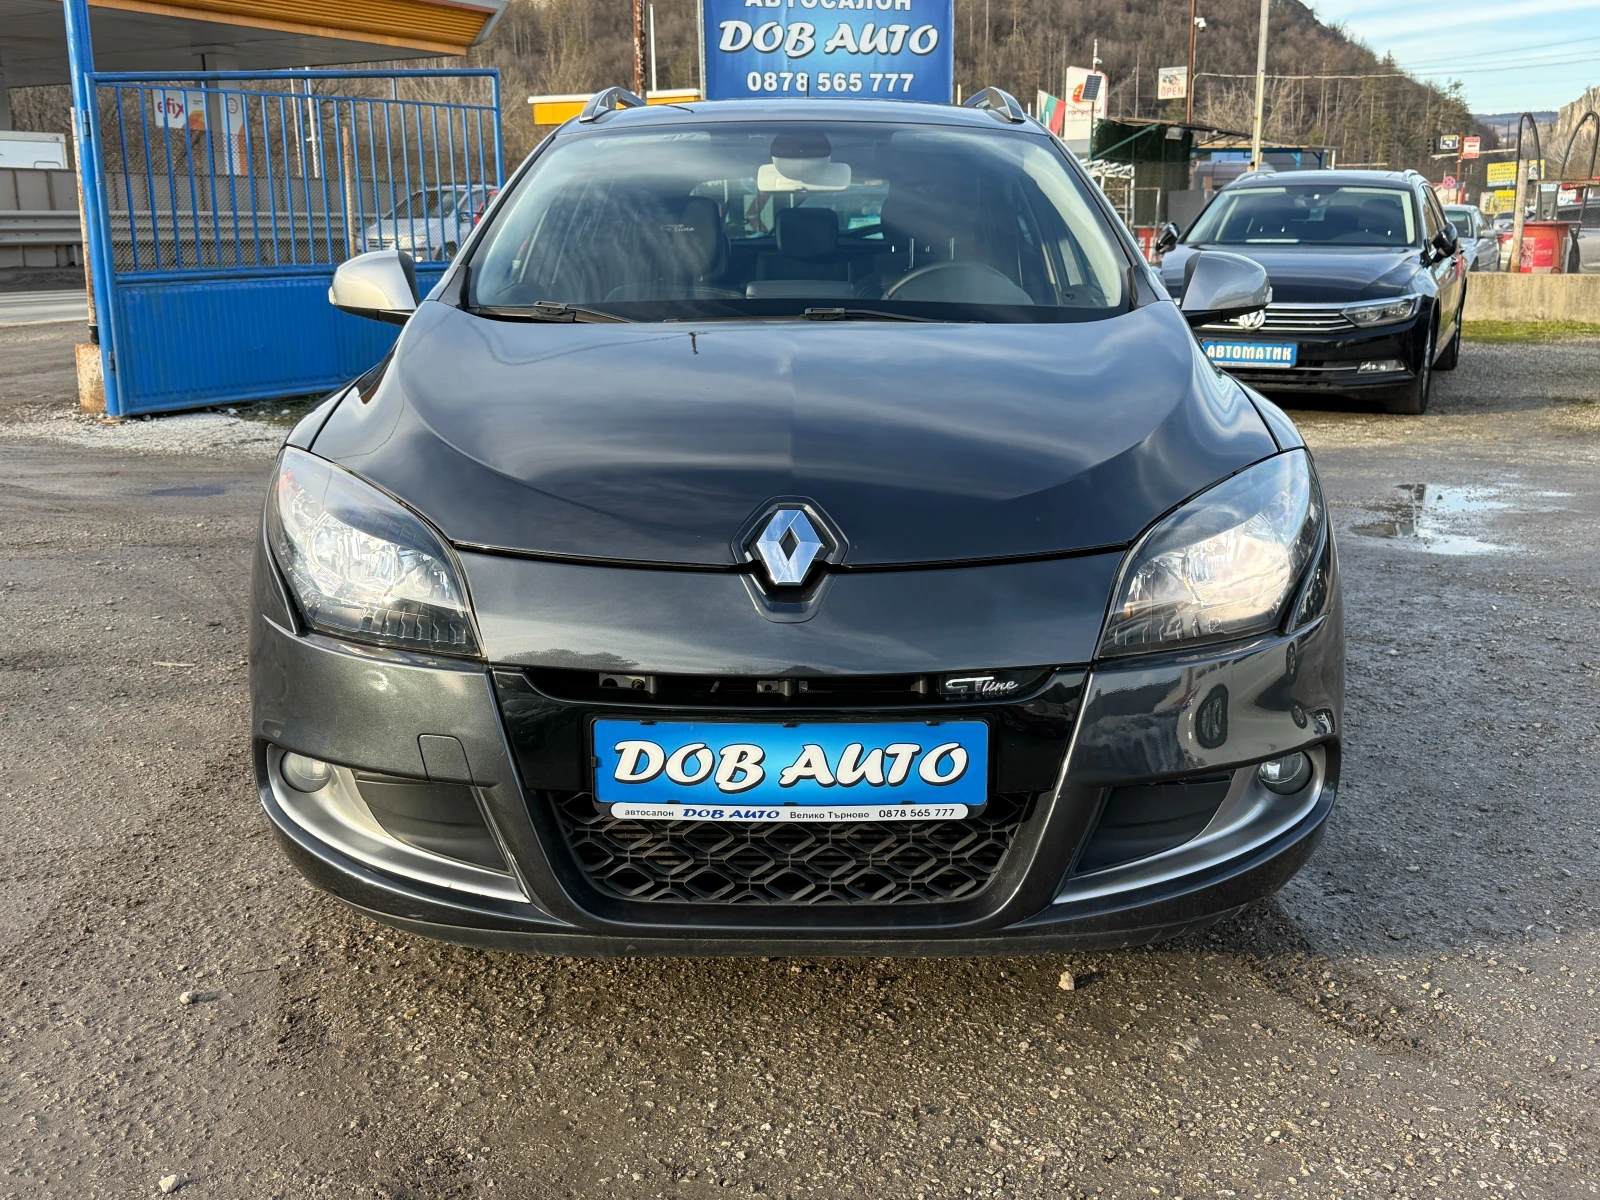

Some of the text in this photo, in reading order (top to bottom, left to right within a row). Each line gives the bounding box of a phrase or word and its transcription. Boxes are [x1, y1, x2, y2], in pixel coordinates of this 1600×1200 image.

[718, 20, 939, 57] DOB AUTO
[746, 71, 914, 93] 0878 565 777
[1161, 86, 1184, 97] OPEN
[1067, 107, 1101, 116] rompeol
[1206, 344, 1293, 361] АВТОМАТИК
[613, 740, 970, 793] DOB AUTO
[624, 808, 955, 820] автосалон DOB AUTO Велико Търново 0878 565 777
